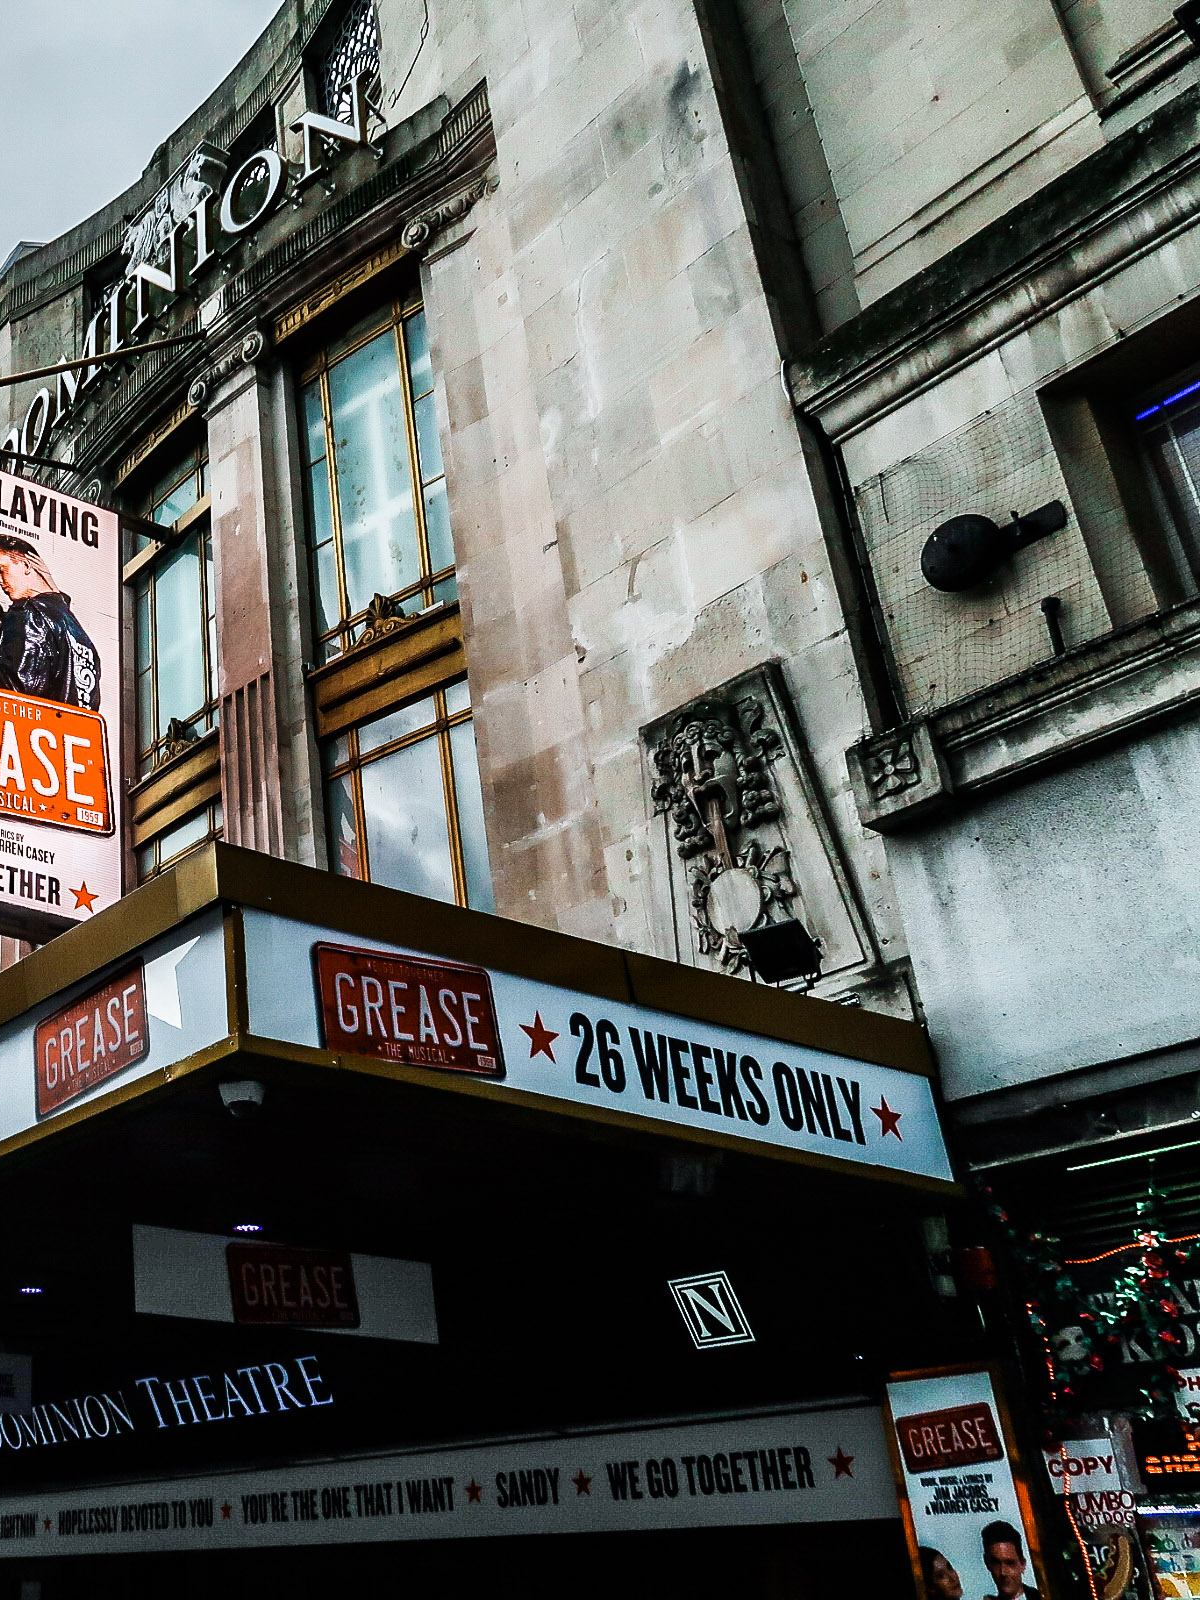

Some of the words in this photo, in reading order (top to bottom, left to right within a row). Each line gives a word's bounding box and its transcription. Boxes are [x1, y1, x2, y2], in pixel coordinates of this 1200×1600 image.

[80, 810, 99, 824] 1959
[16, 833, 25, 843] BY
[26, 846, 56, 865] CASEY
[335, 972, 488, 1051] GREASE
[45, 983, 139, 1089] GREASE
[385, 1042, 402, 1058] THE
[408, 1044, 449, 1063] MUSICAL
[569, 1012, 626, 1093] 26
[628, 1026, 771, 1126] WEEKS
[772, 1061, 866, 1146] ONLY
[241, 1262, 348, 1309] GREASE
[681, 1280, 735, 1338] N
[136, 1355, 334, 1430] THEATRE
[908, 1417, 992, 1458] GREASE
[1048, 1456, 1113, 1477] COPY
[58, 1505, 118, 1535] HOPELESSLY
[121, 1502, 169, 1532] DEVOTED
[171, 1500, 187, 1528] TO
[189, 1498, 213, 1527] YOU
[241, 1491, 288, 1525] YOU'RE
[292, 1488, 318, 1520] THE
[321, 1486, 351, 1518] ONE
[354, 1482, 393, 1516] THAT
[397, 1481, 403, 1514] I
[406, 1477, 454, 1513] WANT
[496, 1468, 559, 1508] SANDY
[606, 1460, 643, 1500] WE
[646, 1458, 679, 1498] GO
[681, 1446, 815, 1495] TOGETHER
[930, 1500, 969, 1514] WARREN
[970, 1498, 999, 1512] CASEY
[933, 1487, 951, 1500] JIM
[952, 1484, 988, 1499] JACOBS
